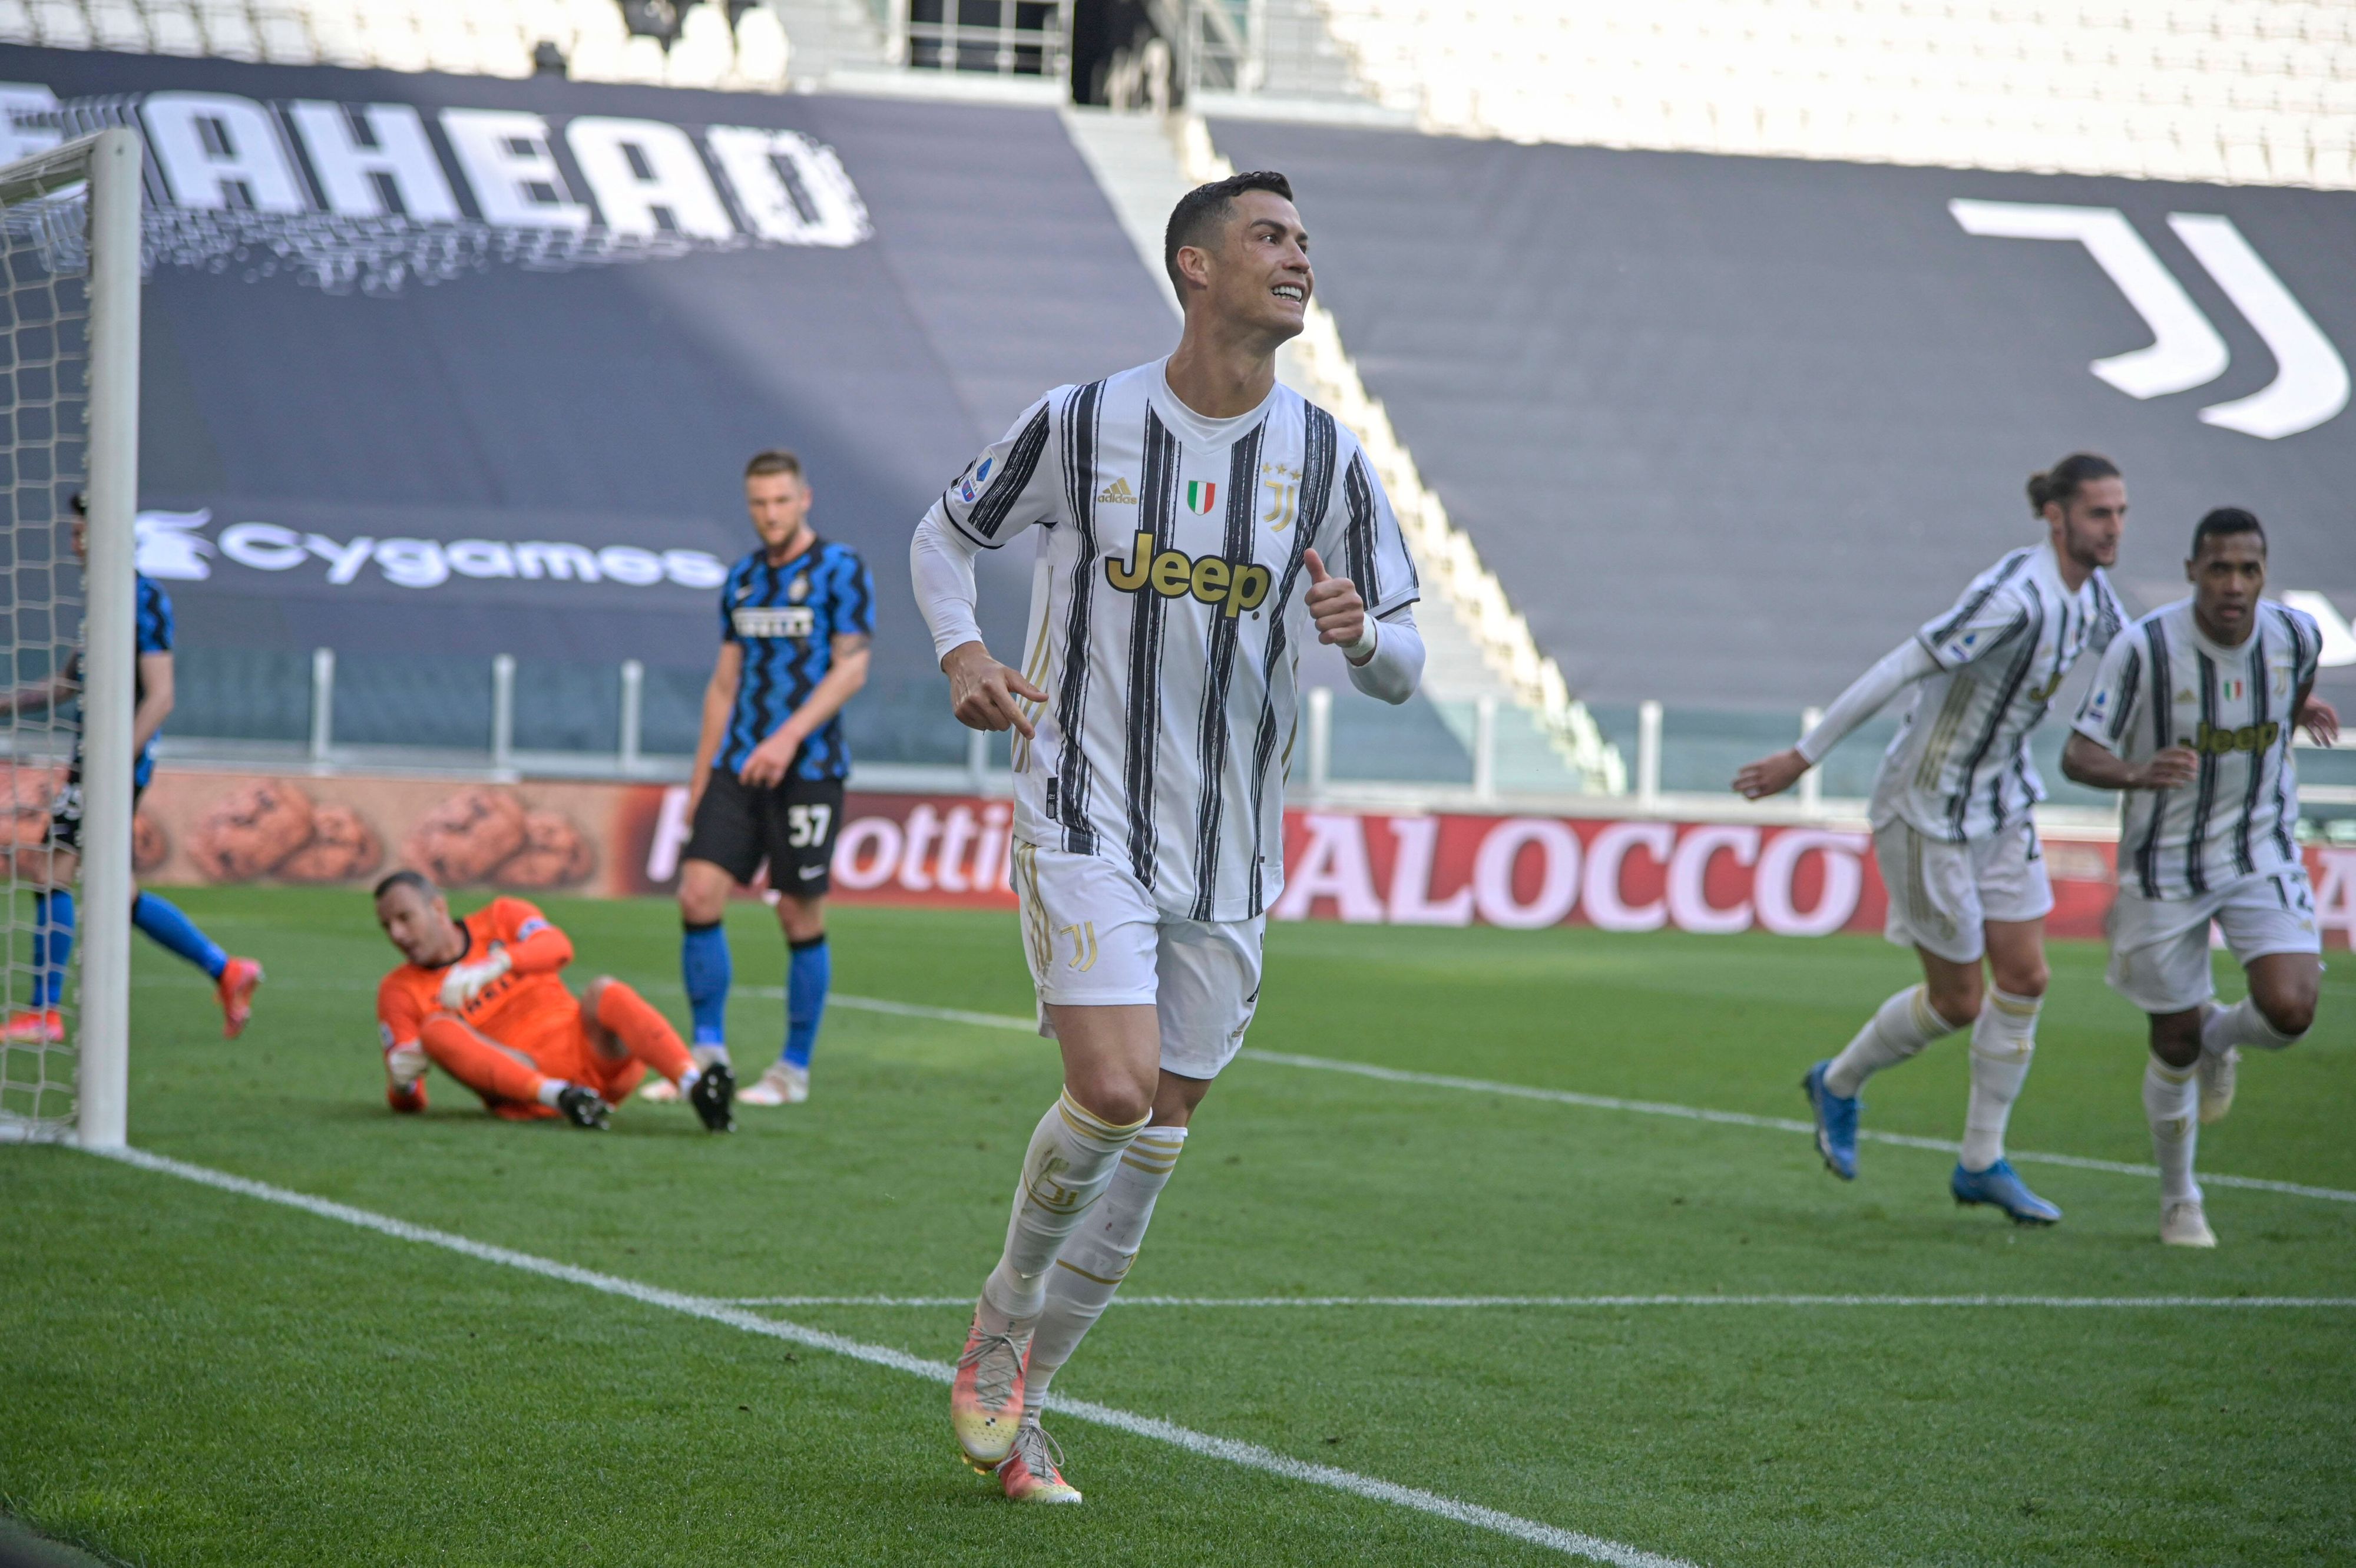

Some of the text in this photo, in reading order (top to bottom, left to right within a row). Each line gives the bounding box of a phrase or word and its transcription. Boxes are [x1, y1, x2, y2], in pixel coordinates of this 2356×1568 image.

[140, 90, 873, 248] AHEAD
[1097, 493, 1137, 504] adidas
[217, 522, 729, 589] Cygames
[1105, 530, 1272, 619] Jeep
[1268, 812, 1871, 938] ALOCCO
